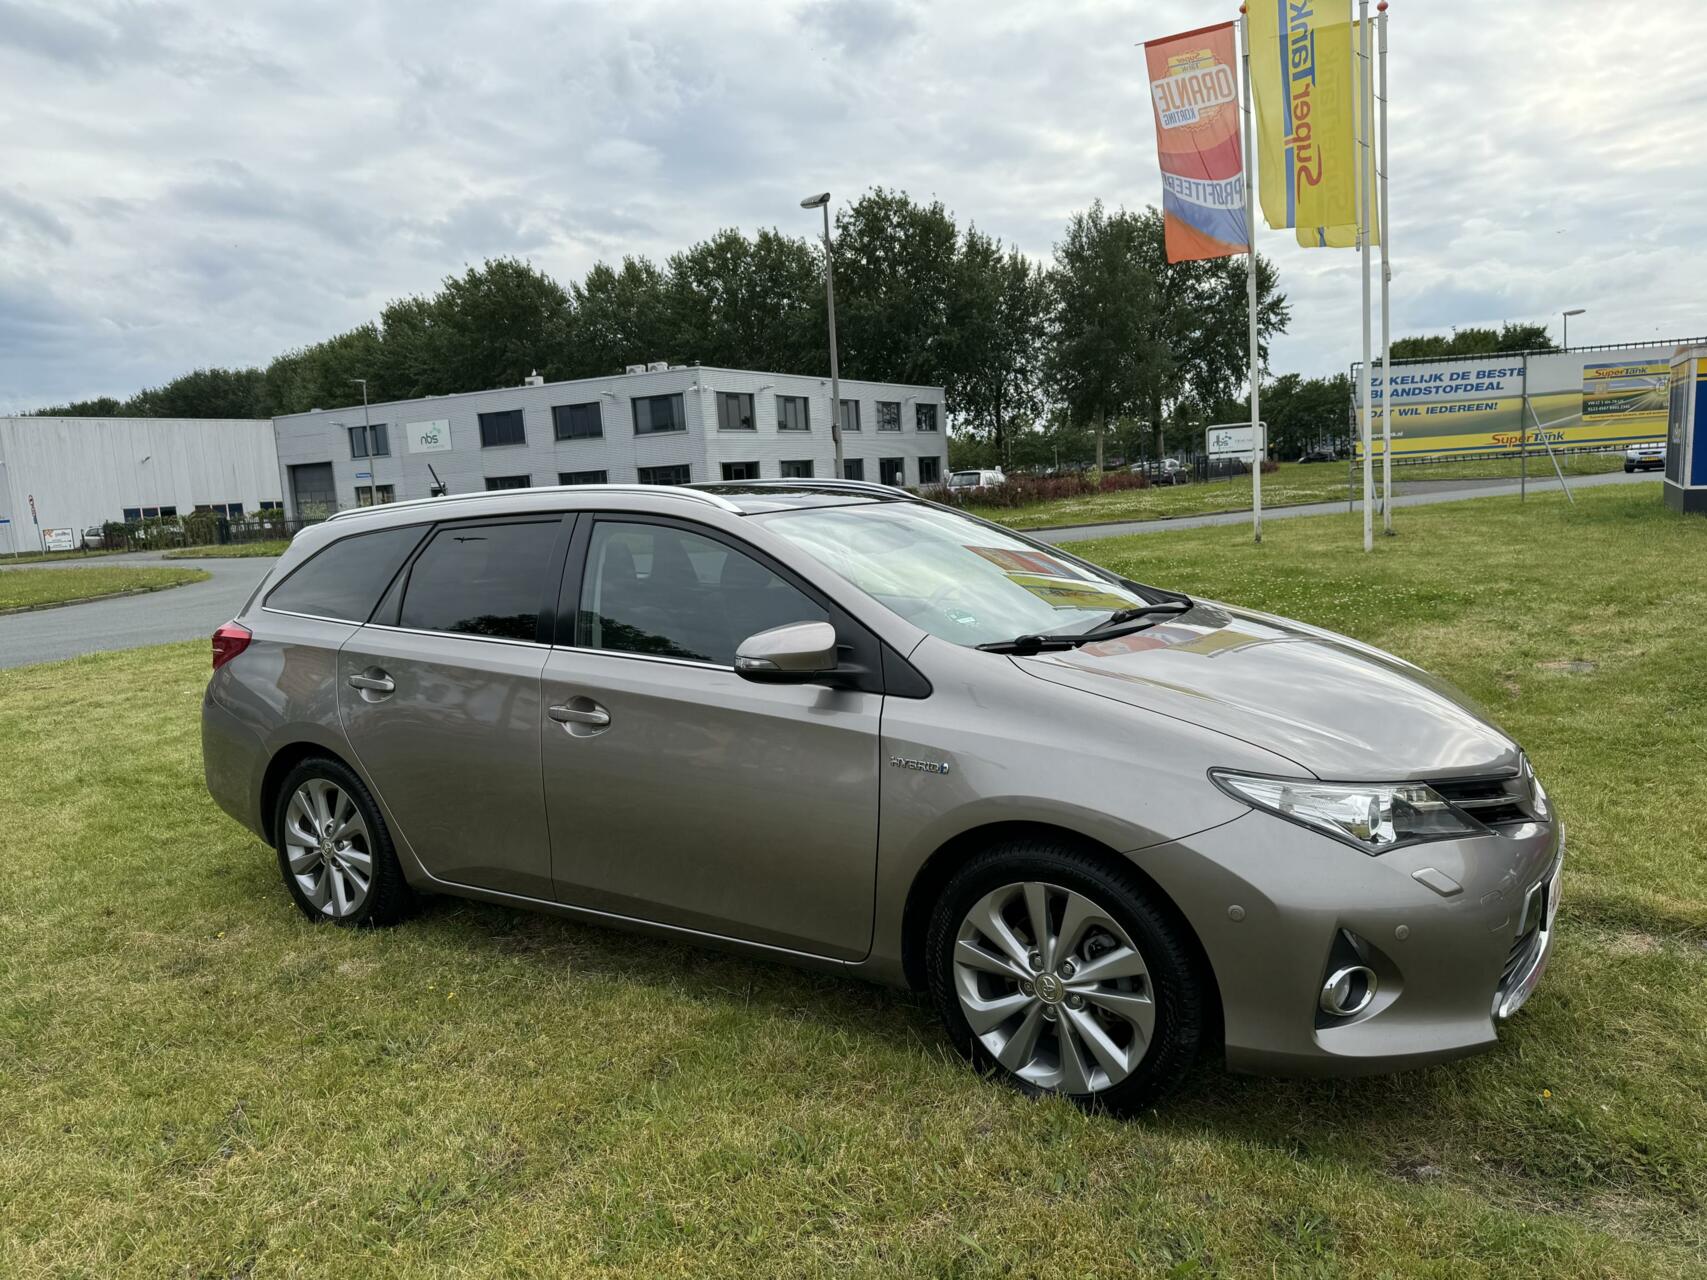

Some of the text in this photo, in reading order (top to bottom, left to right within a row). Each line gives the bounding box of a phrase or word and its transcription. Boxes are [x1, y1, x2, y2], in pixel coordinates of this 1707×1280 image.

[1449, 371, 1470, 382] DE
[1476, 367, 1527, 380] BESTE
[1594, 367, 1649, 378] SuperTank
[1399, 405, 1421, 417] WIL
[1426, 402, 1499, 415] IEDEREEN!
[420, 432, 439, 446] nbs
